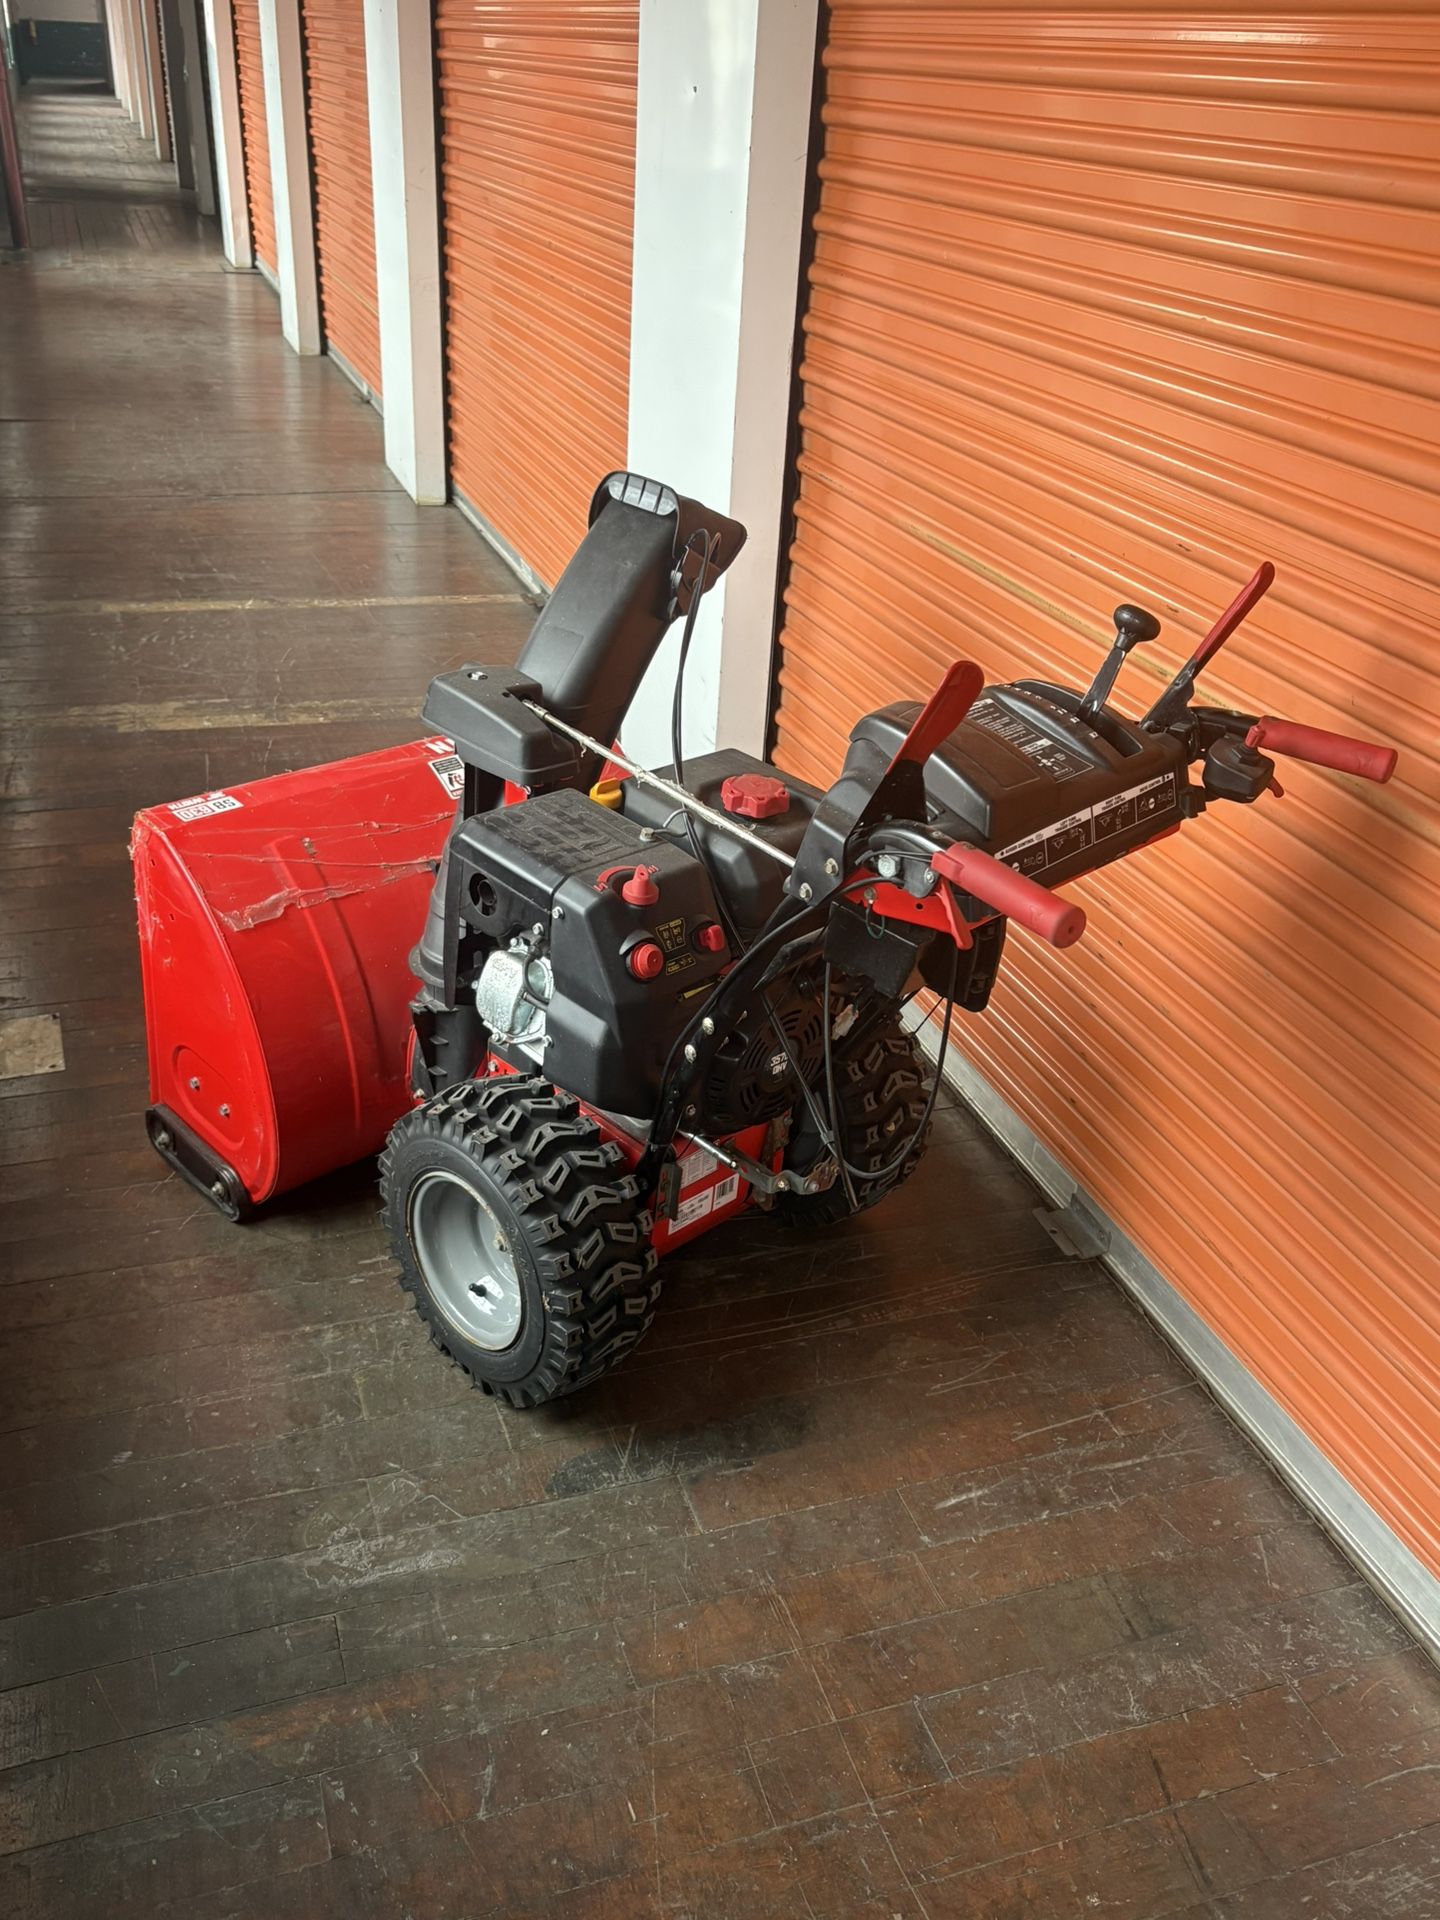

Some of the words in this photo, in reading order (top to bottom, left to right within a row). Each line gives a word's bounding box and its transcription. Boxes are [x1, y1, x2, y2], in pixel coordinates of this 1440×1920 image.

[179, 804, 212, 820] 630
[212, 799, 236, 810] SB
[772, 1060, 788, 1075] OHV
